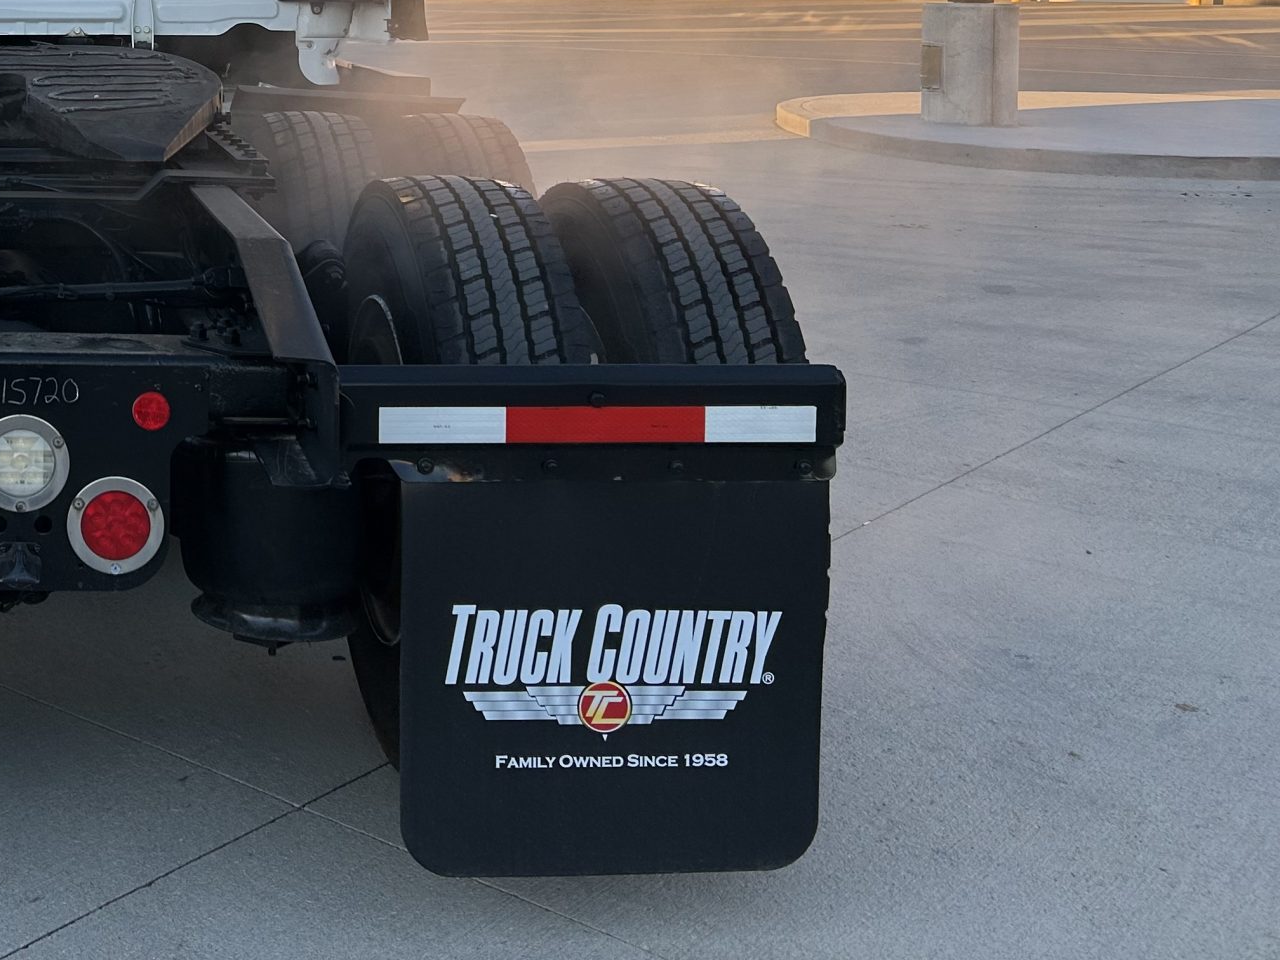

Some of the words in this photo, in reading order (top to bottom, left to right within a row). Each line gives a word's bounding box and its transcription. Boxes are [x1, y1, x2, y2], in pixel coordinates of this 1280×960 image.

[445, 604, 583, 685] TRUCK
[495, 754, 557, 769] FAMILY
[558, 754, 624, 768] OWNED
[627, 753, 679, 768] SINCE
[684, 753, 729, 767] 1958
